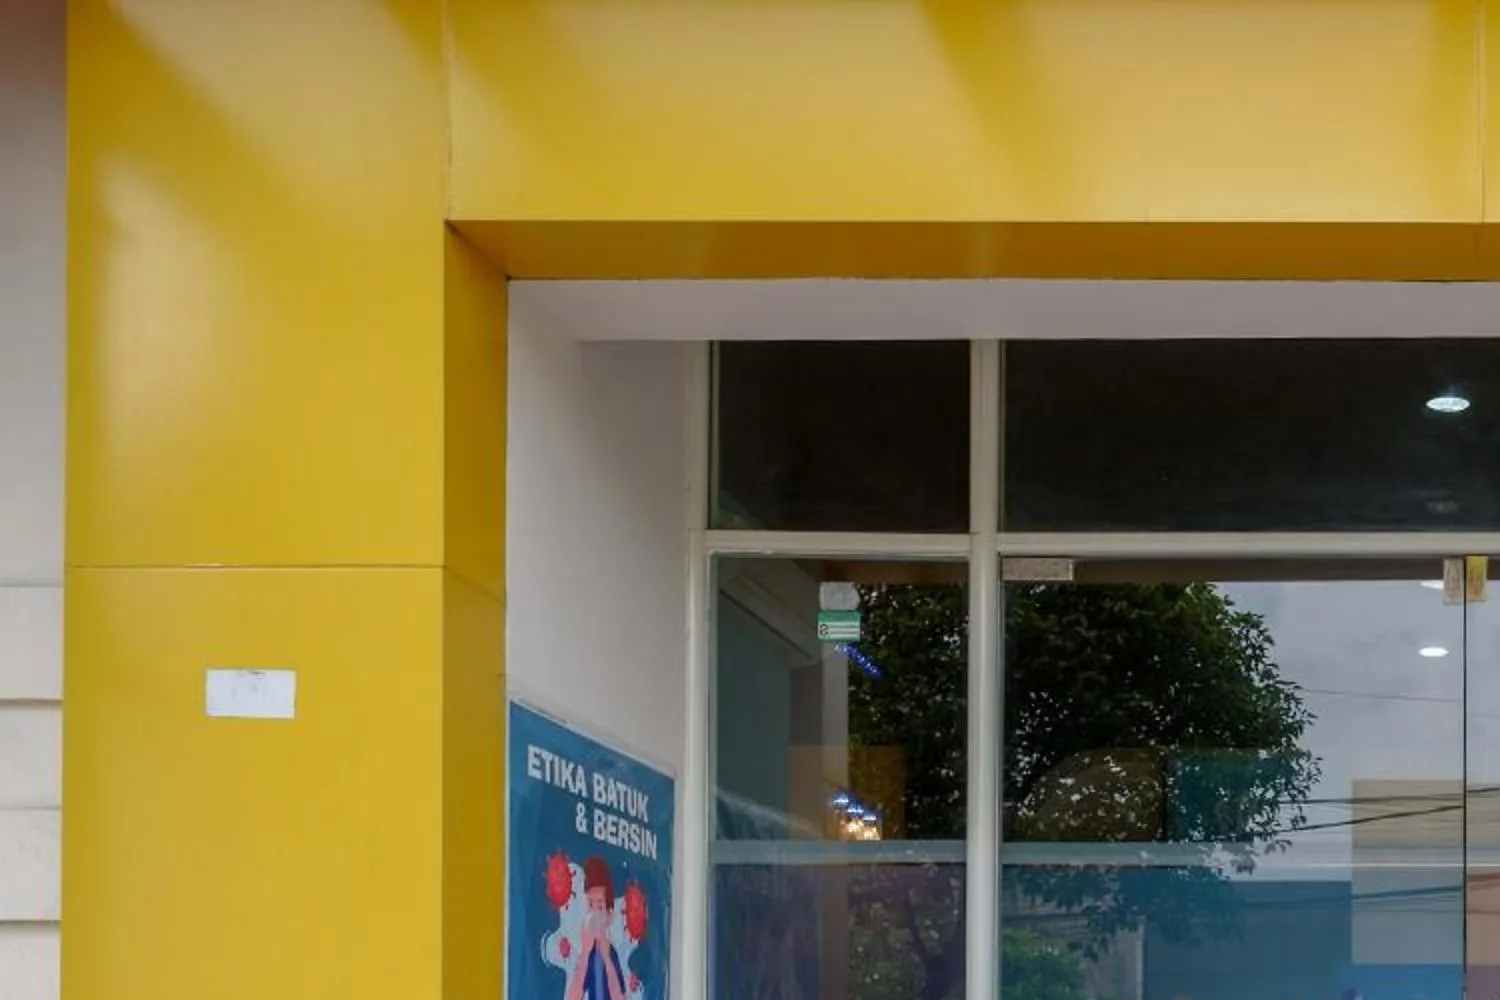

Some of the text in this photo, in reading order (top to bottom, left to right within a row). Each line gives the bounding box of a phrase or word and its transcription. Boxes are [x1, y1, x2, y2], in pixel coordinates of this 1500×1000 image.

[527, 743, 650, 824] ETIKA BATUK
[575, 801, 658, 861] & BERSIN
